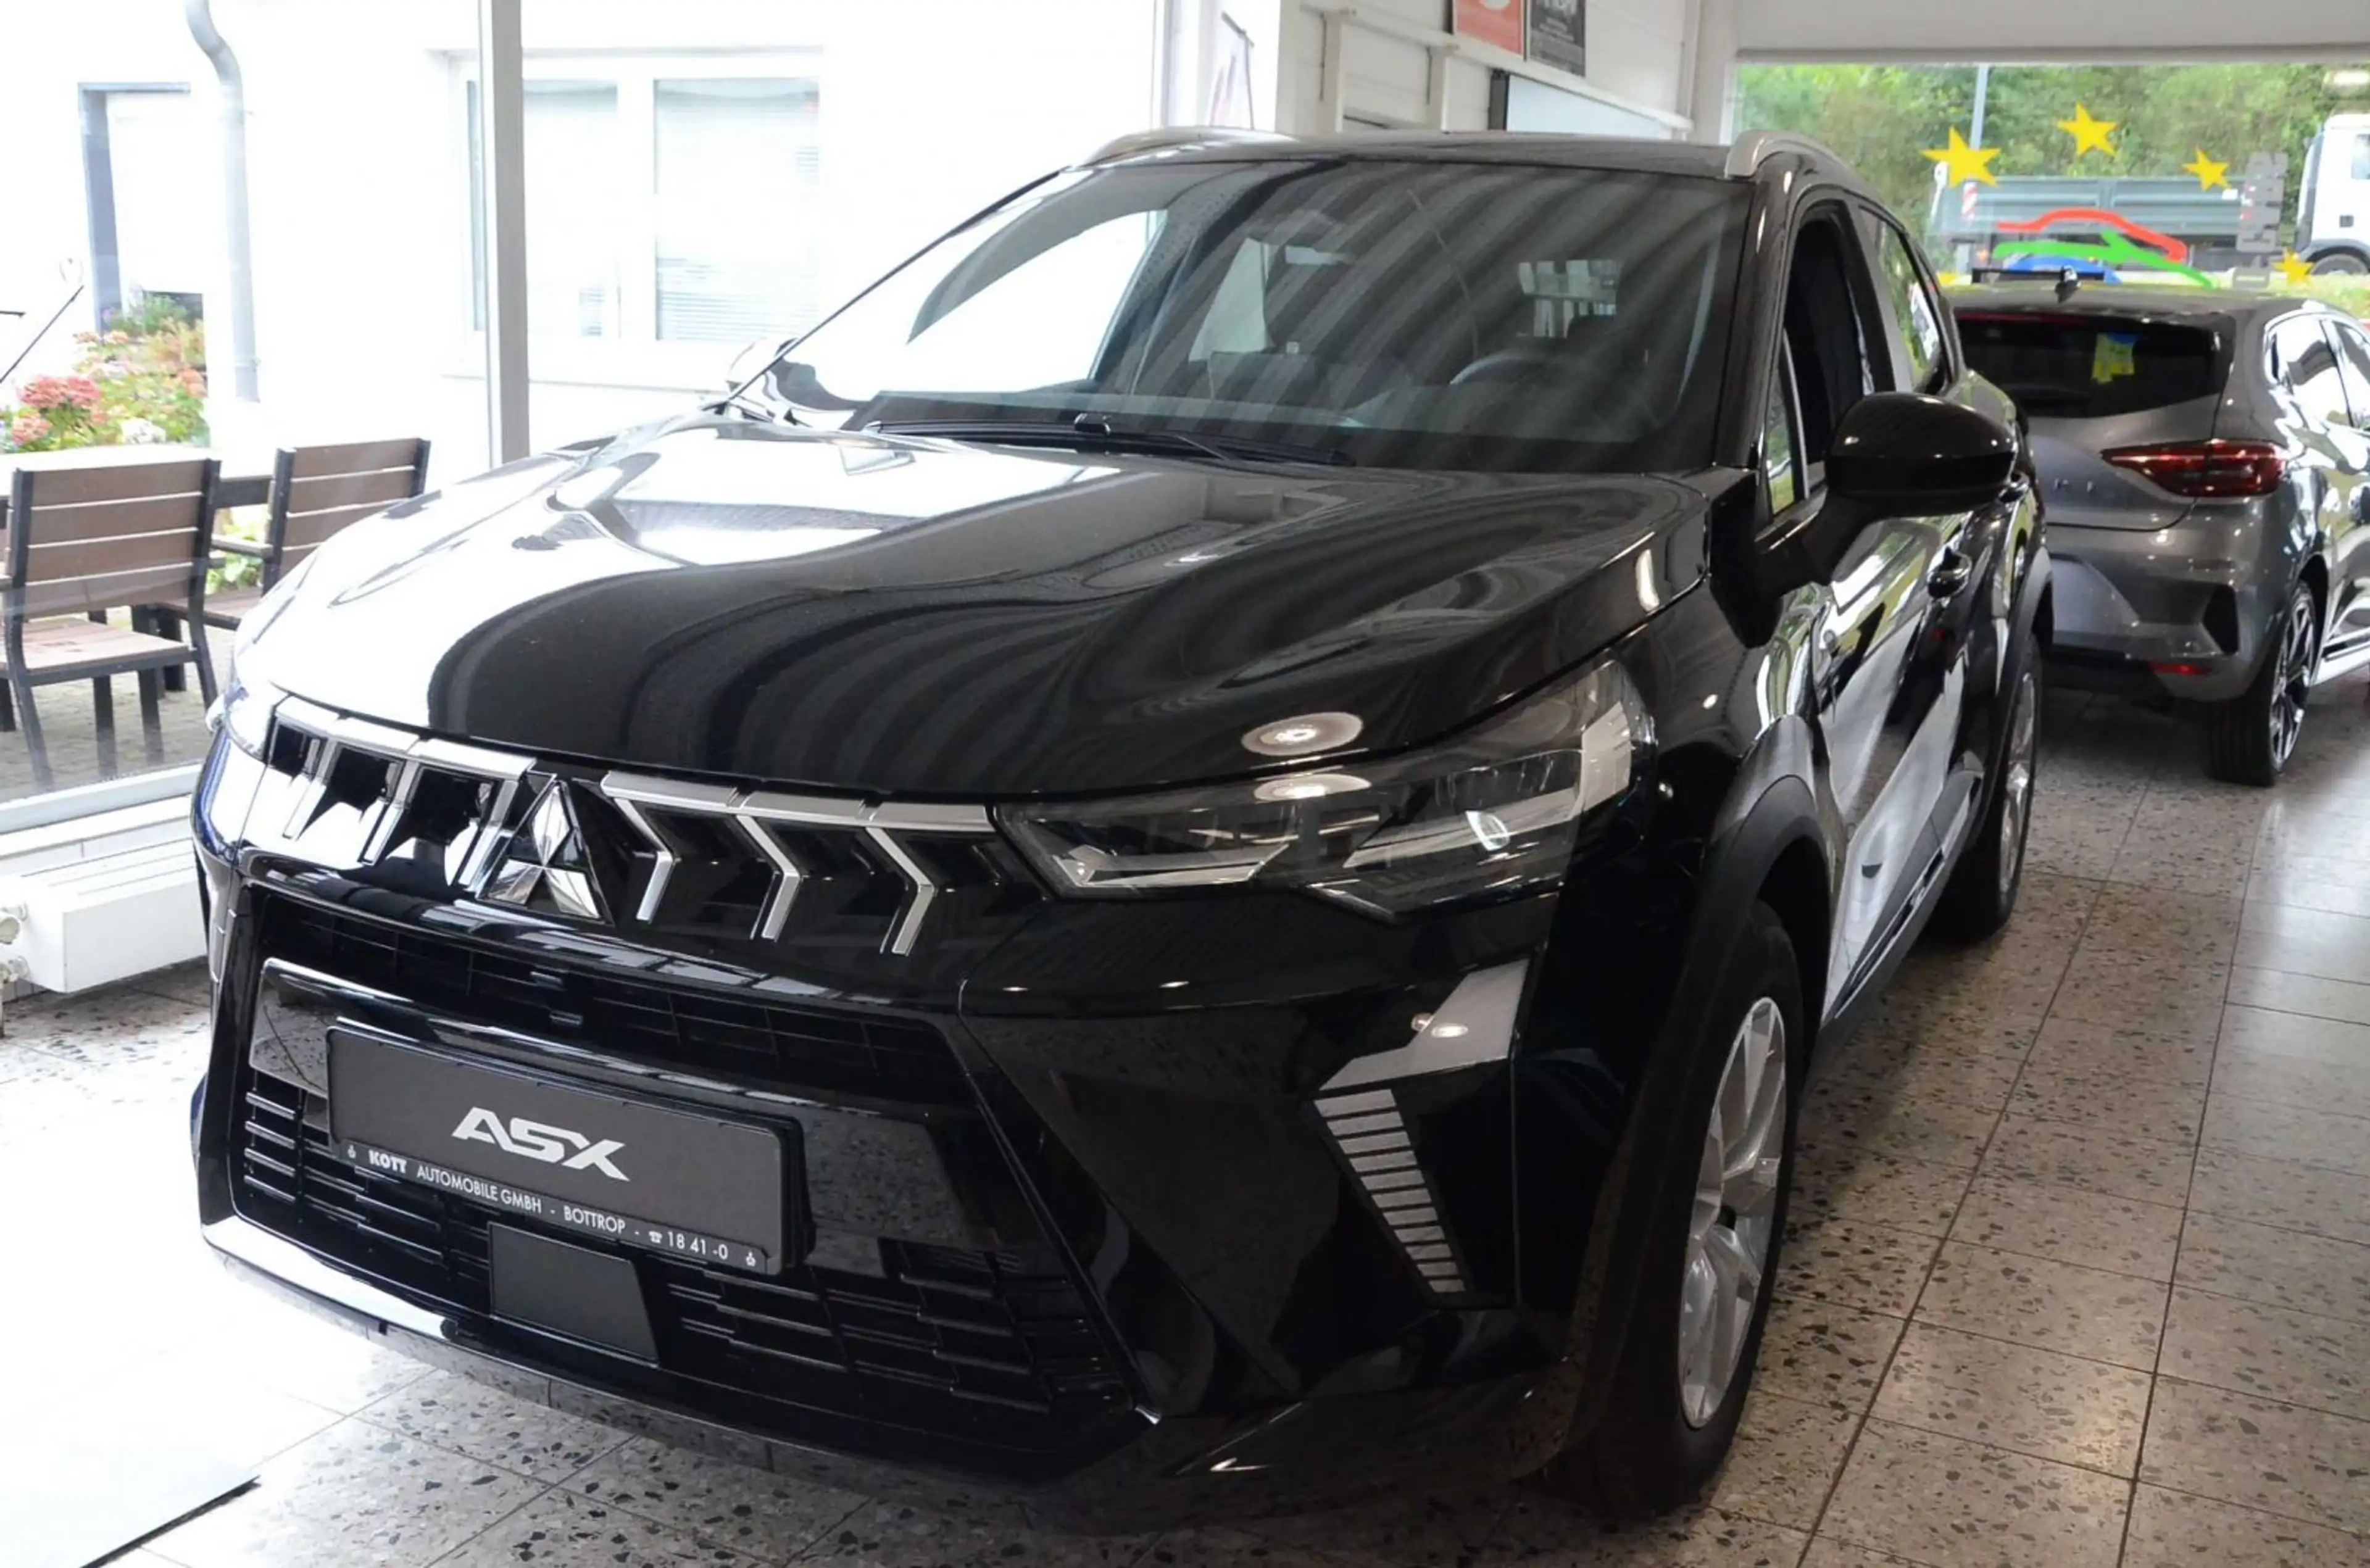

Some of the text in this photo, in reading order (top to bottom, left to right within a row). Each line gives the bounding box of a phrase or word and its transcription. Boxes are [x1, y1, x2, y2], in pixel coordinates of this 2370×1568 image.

[451, 1106, 630, 1182] ASX
[368, 1149, 407, 1174] KOTT
[417, 1164, 498, 1201] AUTOMOBILE
[501, 1189, 542, 1214] GMBH
[563, 1205, 626, 1234] BOTTROP
